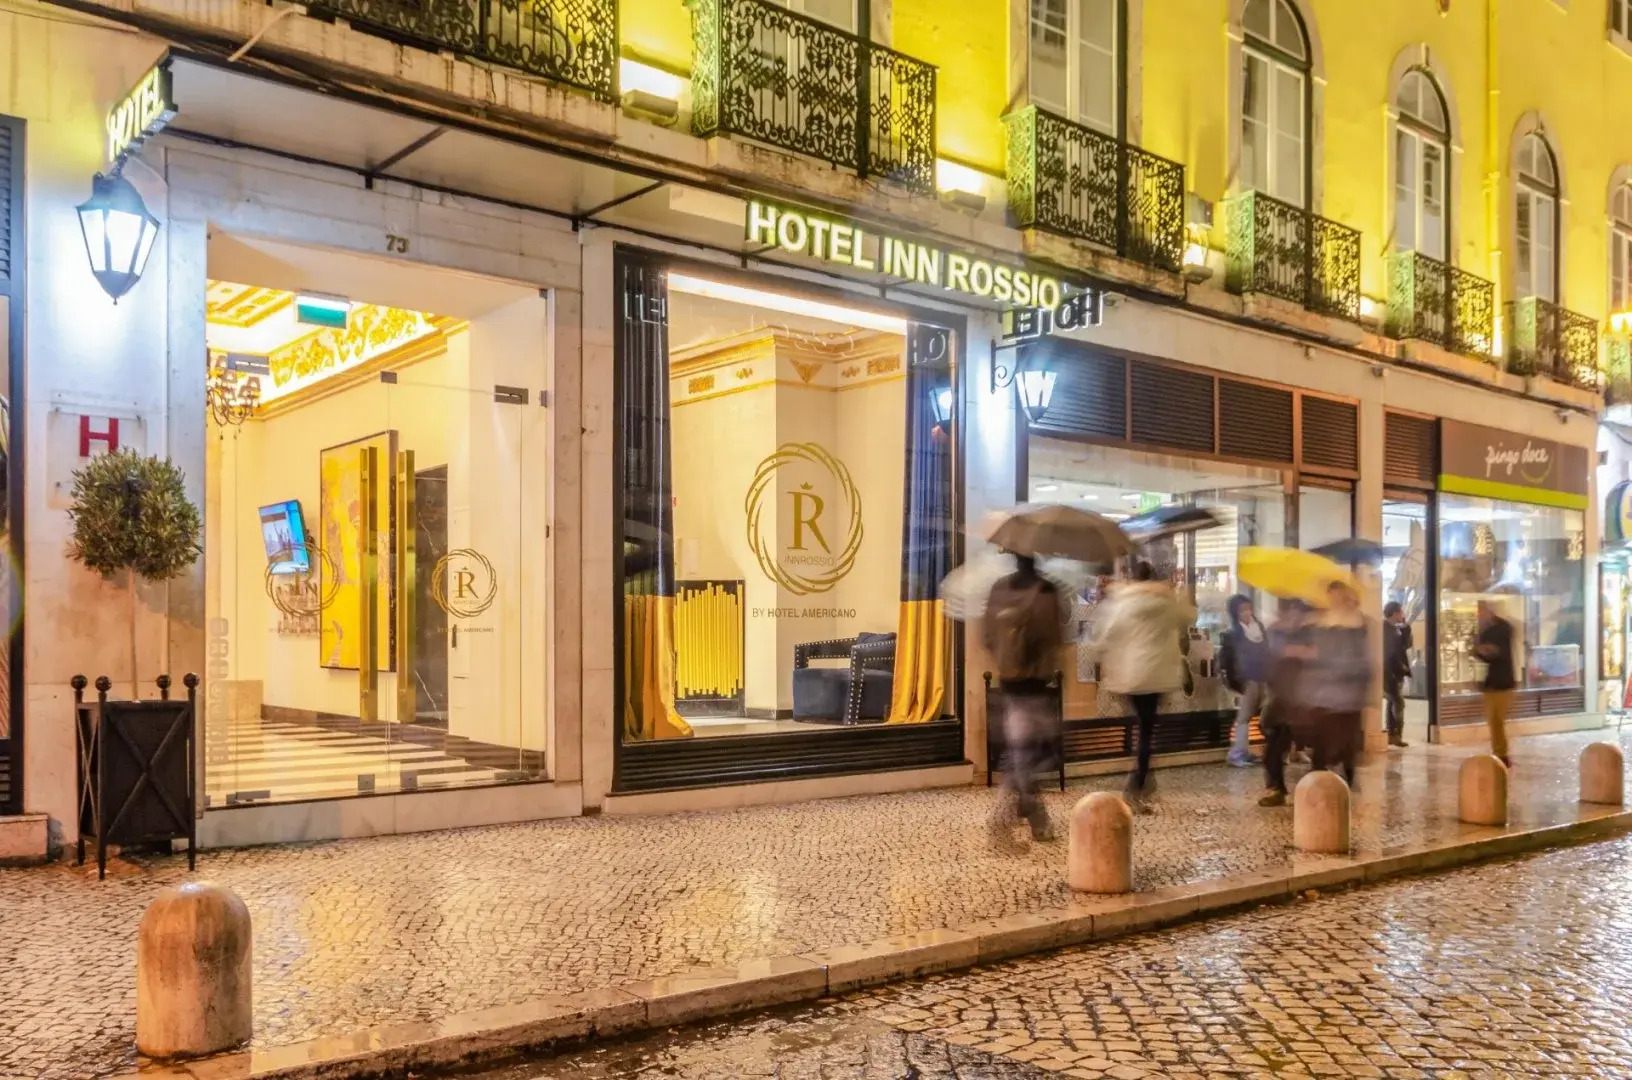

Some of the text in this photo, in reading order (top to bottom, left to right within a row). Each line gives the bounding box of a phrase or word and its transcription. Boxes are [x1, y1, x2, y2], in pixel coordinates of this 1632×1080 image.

[107, 65, 165, 162] HOTEL
[385, 234, 408, 253] 73
[750, 201, 1060, 311] HOTEL INN ROSSIO
[80, 415, 119, 457] H
[1485, 440, 1549, 478] pingo doce
[786, 491, 831, 554] R
[455, 571, 480, 599] R
[752, 608, 857, 618] BY HOTEL AMERICANO
